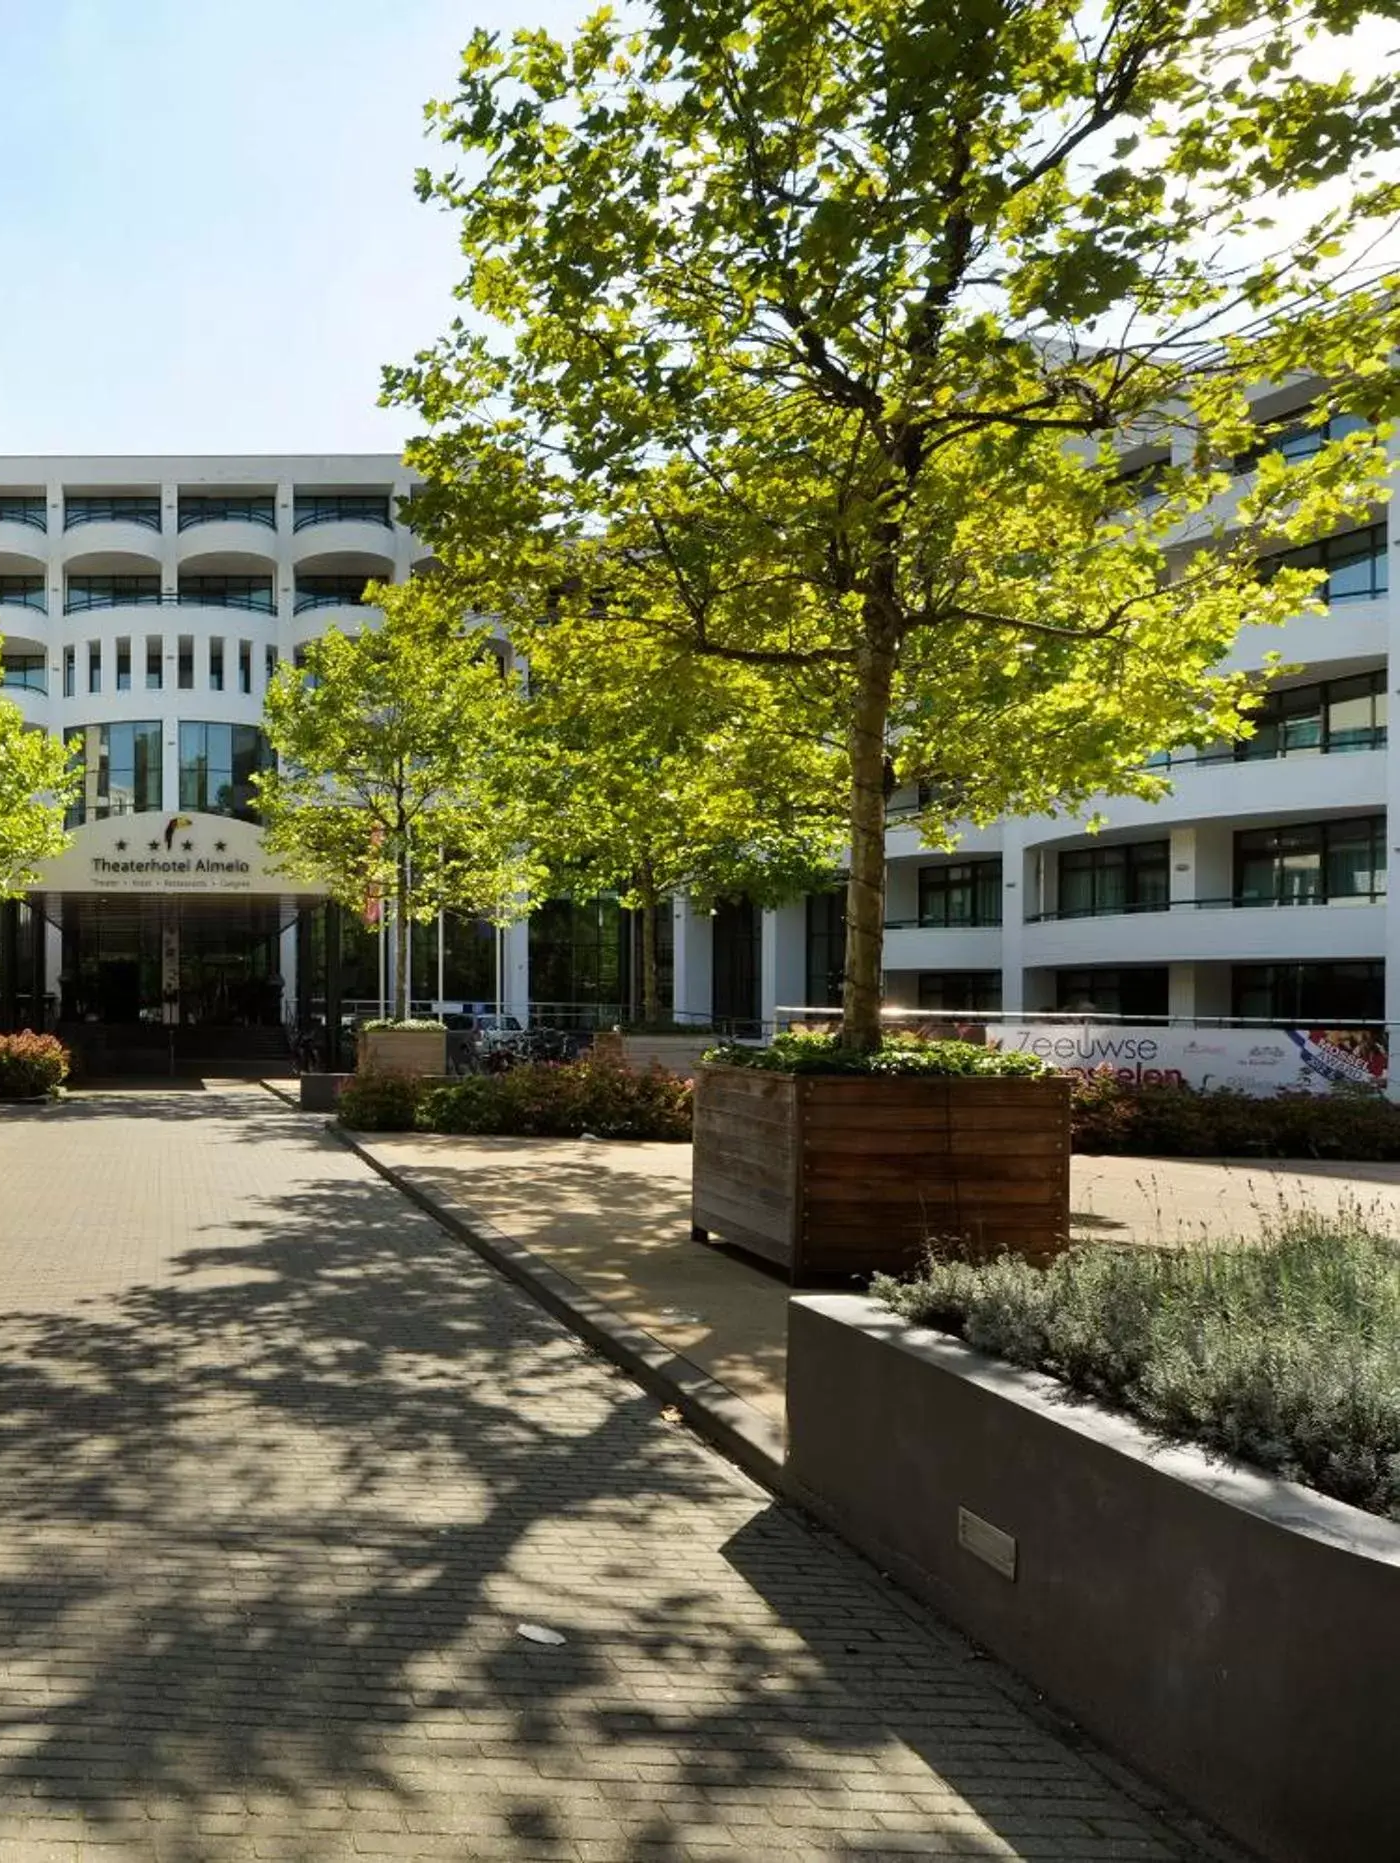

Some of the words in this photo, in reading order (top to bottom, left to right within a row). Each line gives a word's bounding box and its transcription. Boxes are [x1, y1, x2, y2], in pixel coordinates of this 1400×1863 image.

[92, 858, 190, 873] Theaterhotel
[196, 858, 250, 873] Almelo
[1017, 1031, 1157, 1060] Zeeuwse
